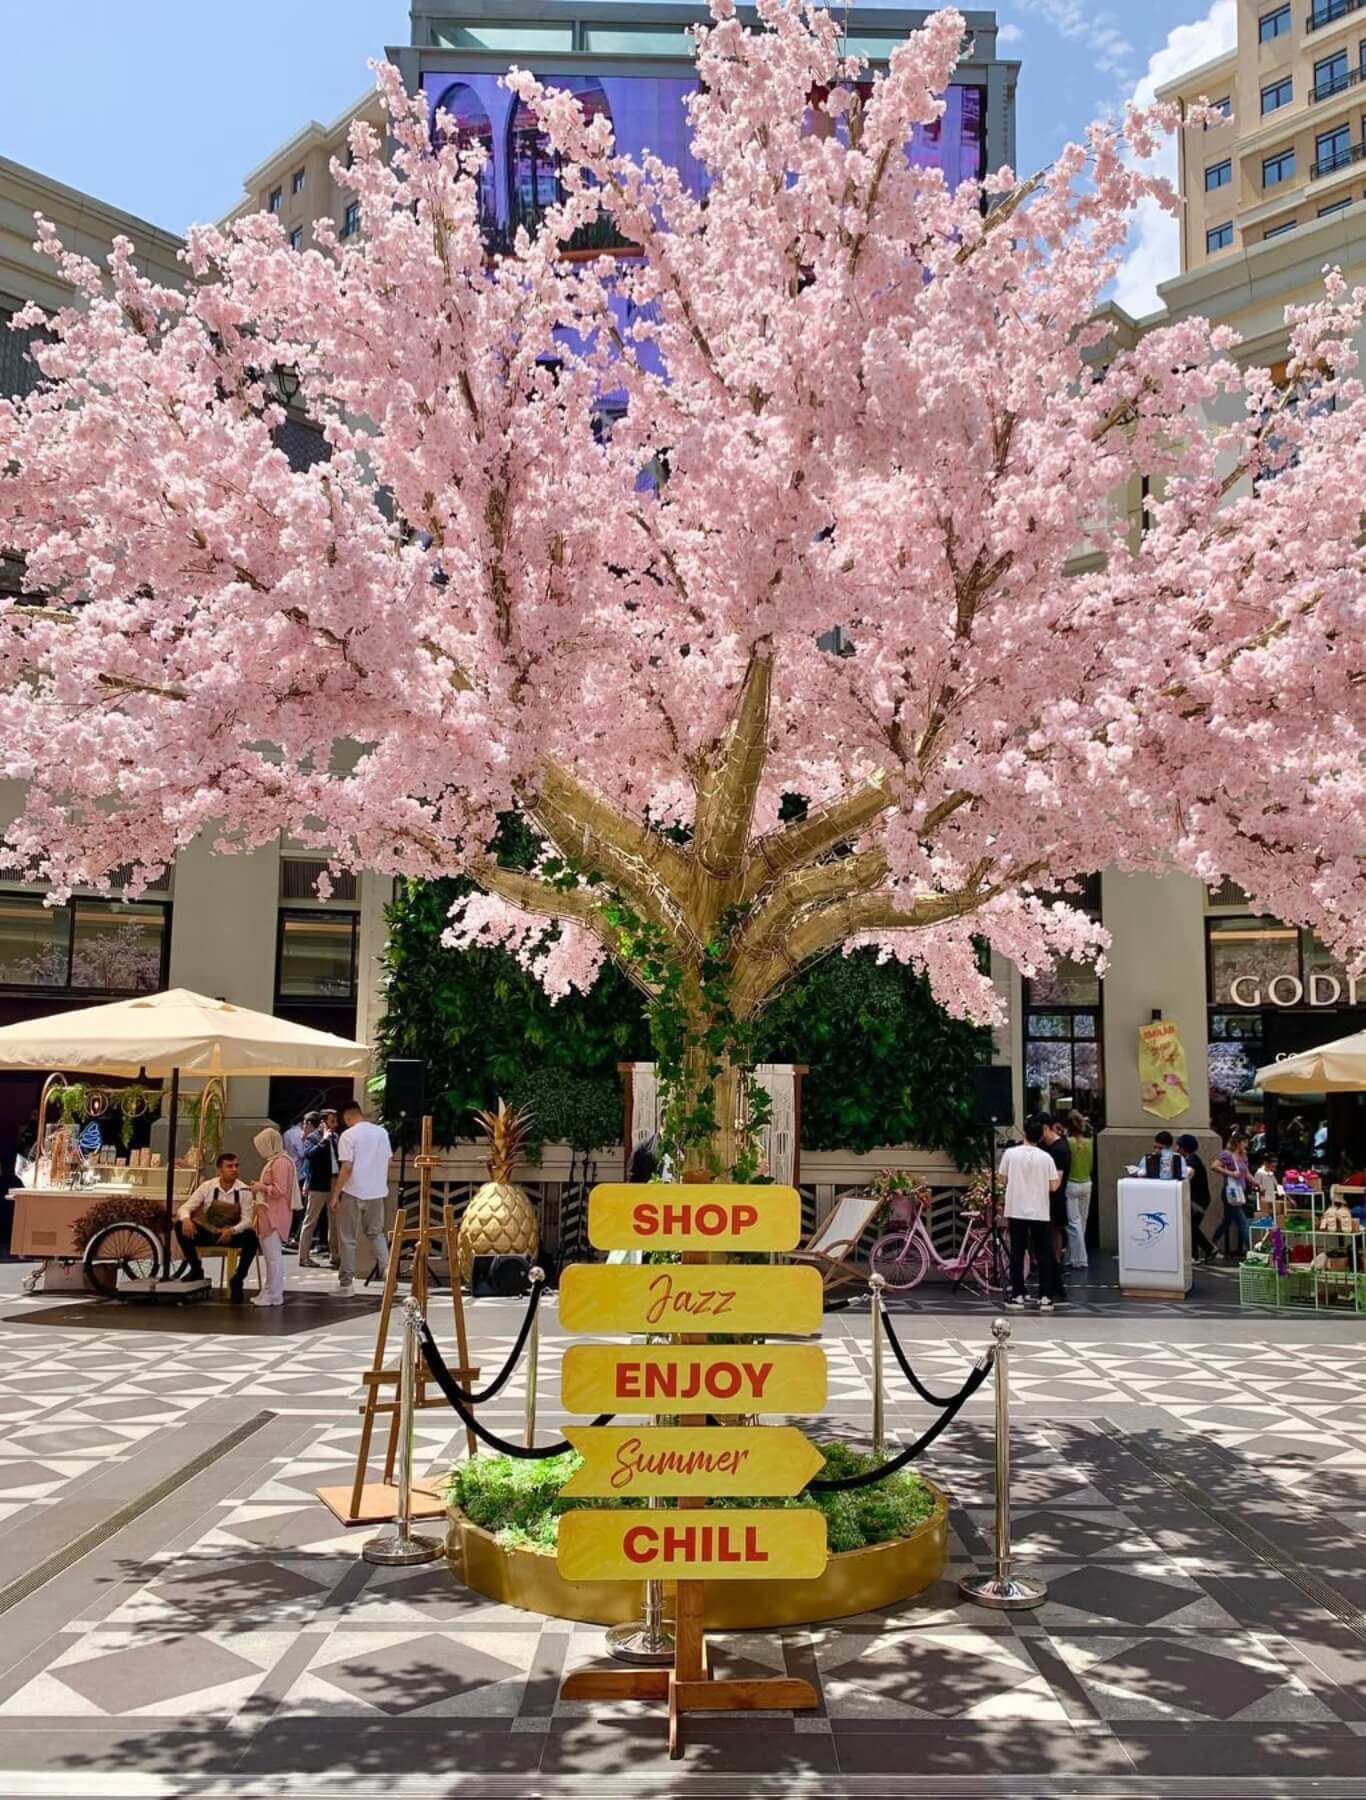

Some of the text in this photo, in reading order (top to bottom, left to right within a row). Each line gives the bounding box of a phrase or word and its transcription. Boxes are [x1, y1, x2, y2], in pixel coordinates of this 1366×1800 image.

[1230, 974, 1366, 1007] GODI
[632, 1203, 759, 1237] SHOP
[646, 1273, 737, 1324] Jazz
[615, 1361, 774, 1399] ENJOY
[610, 1437, 750, 1489] Summer
[622, 1525, 769, 1564] CHILL
